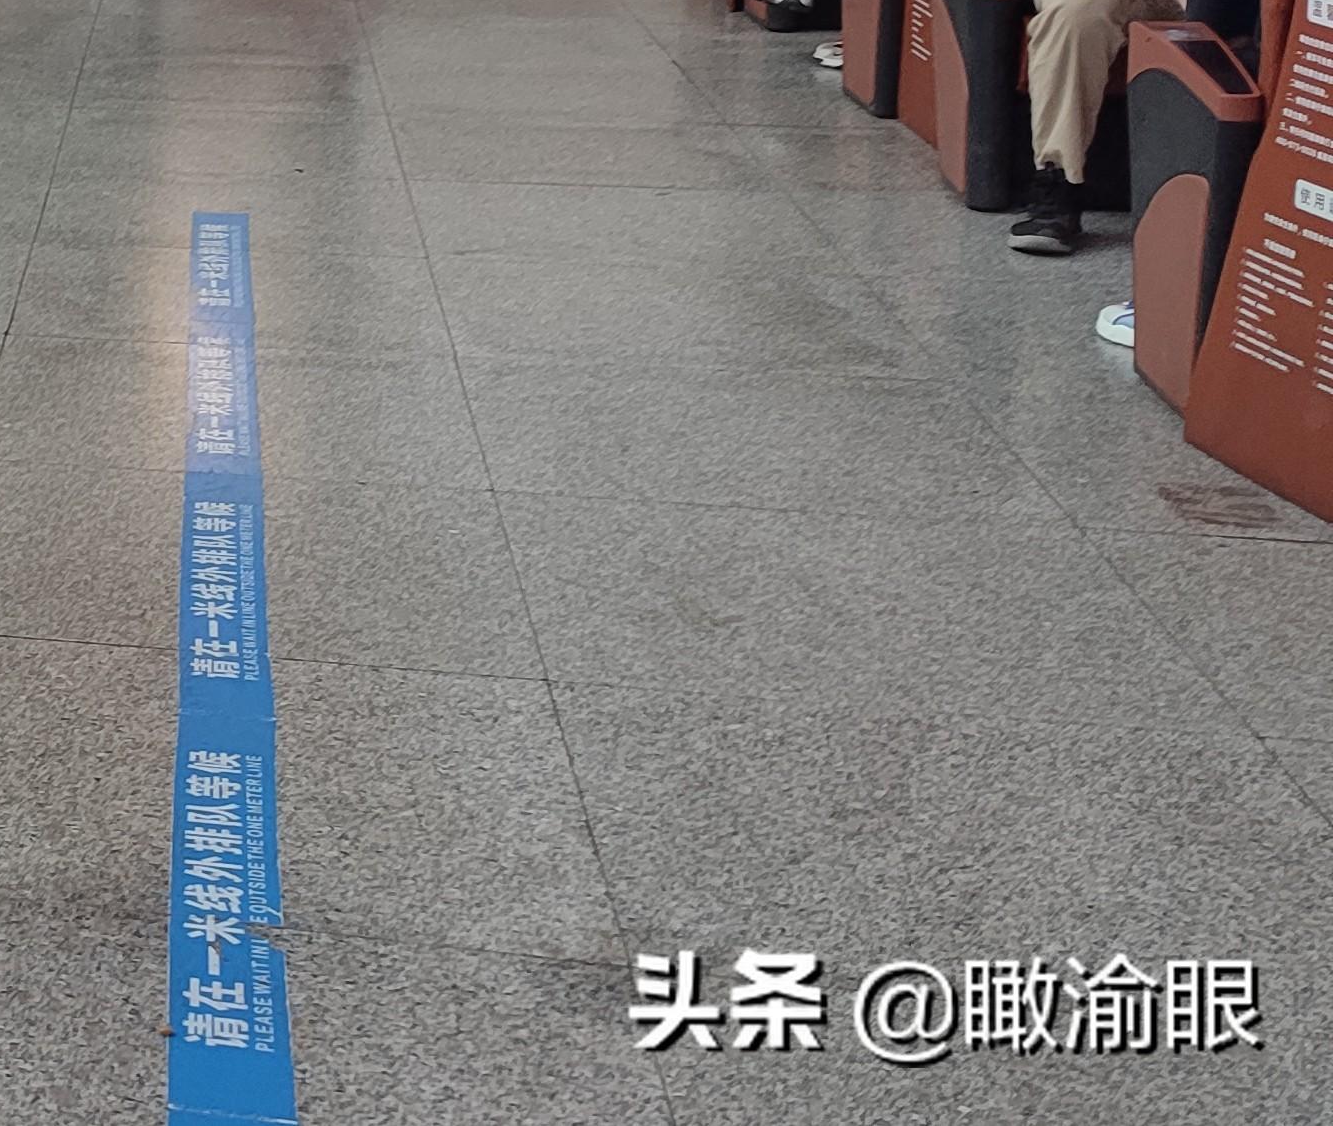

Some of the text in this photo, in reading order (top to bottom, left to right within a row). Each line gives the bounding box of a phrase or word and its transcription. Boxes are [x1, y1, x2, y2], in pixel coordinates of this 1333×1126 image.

[190, 501, 240, 679] 请在一米线外排队等候
[242, 648, 260, 681] PLEASE
[246, 778, 263, 814] METER
[246, 815, 263, 835] ONE
[247, 838, 264, 860] THE
[182, 750, 250, 1049] 请在一米线外排队等候
[247, 862, 267, 914] OUTSIDE
[248, 916, 269, 944] LE
[250, 946, 269, 959] IN
[250, 960, 272, 994] WAIT
[252, 997, 275, 1053] PLEASE
